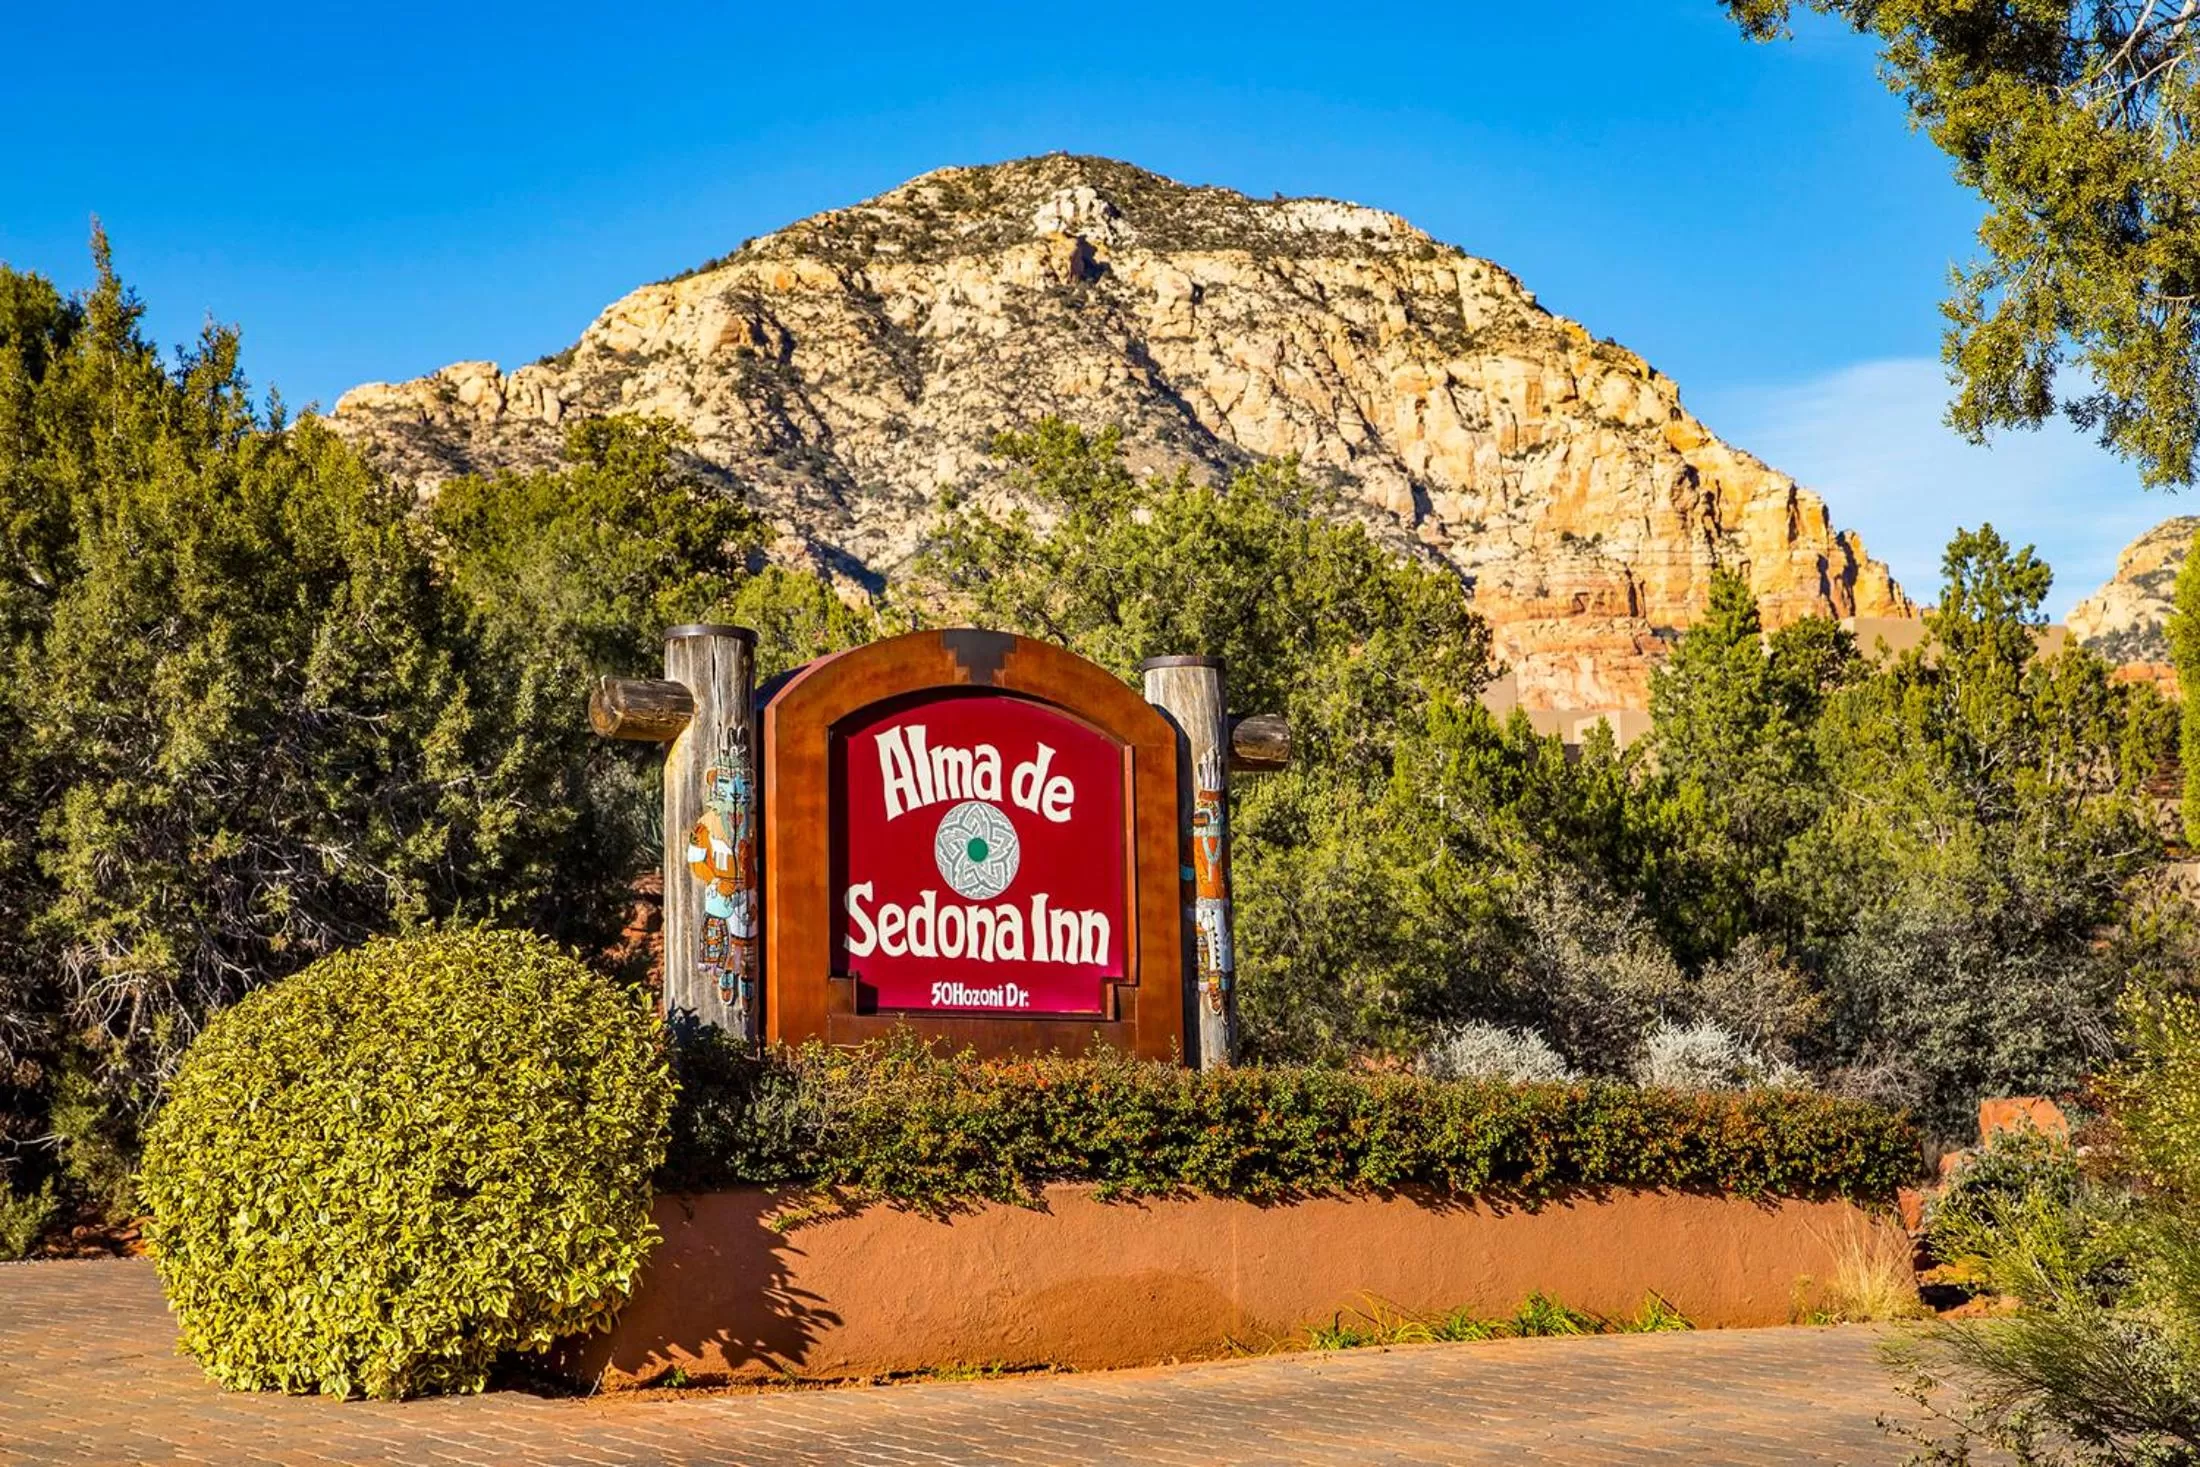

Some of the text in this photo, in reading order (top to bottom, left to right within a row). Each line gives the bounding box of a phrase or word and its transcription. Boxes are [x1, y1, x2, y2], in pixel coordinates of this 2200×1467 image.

[874, 724, 1075, 823] Alma de
[843, 880, 1111, 966] Sedona Inn
[1005, 982, 1030, 1008] Dr.
